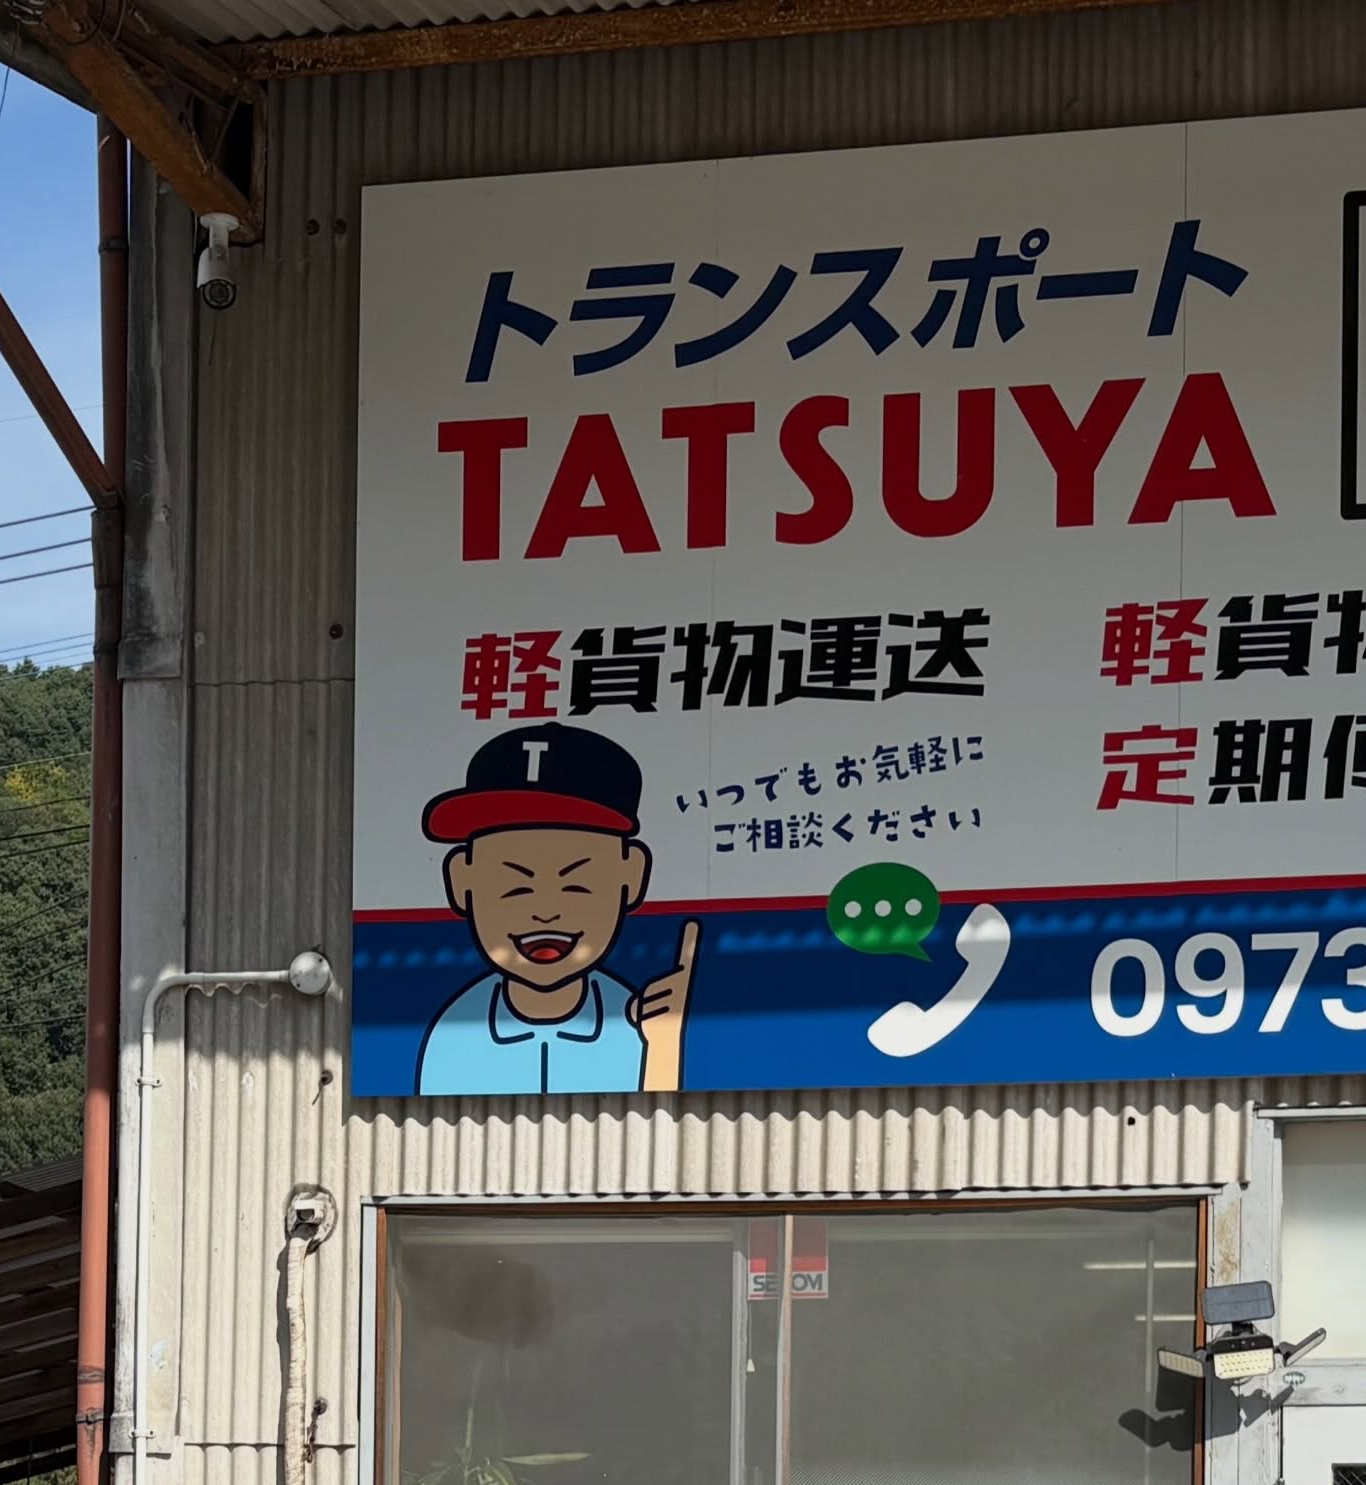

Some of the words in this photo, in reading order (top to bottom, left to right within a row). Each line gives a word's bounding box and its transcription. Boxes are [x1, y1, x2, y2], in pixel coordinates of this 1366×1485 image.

[465, 219, 1249, 383] トランスポート
[437, 371, 1277, 562] TATSUYA
[460, 607, 991, 720] 軽貨物運送
[522, 741, 549, 782] T
[676, 735, 984, 813] いつでもお気軽に
[714, 804, 981, 853] ご相談ください
[752, 1274, 823, 1292] SEOM
